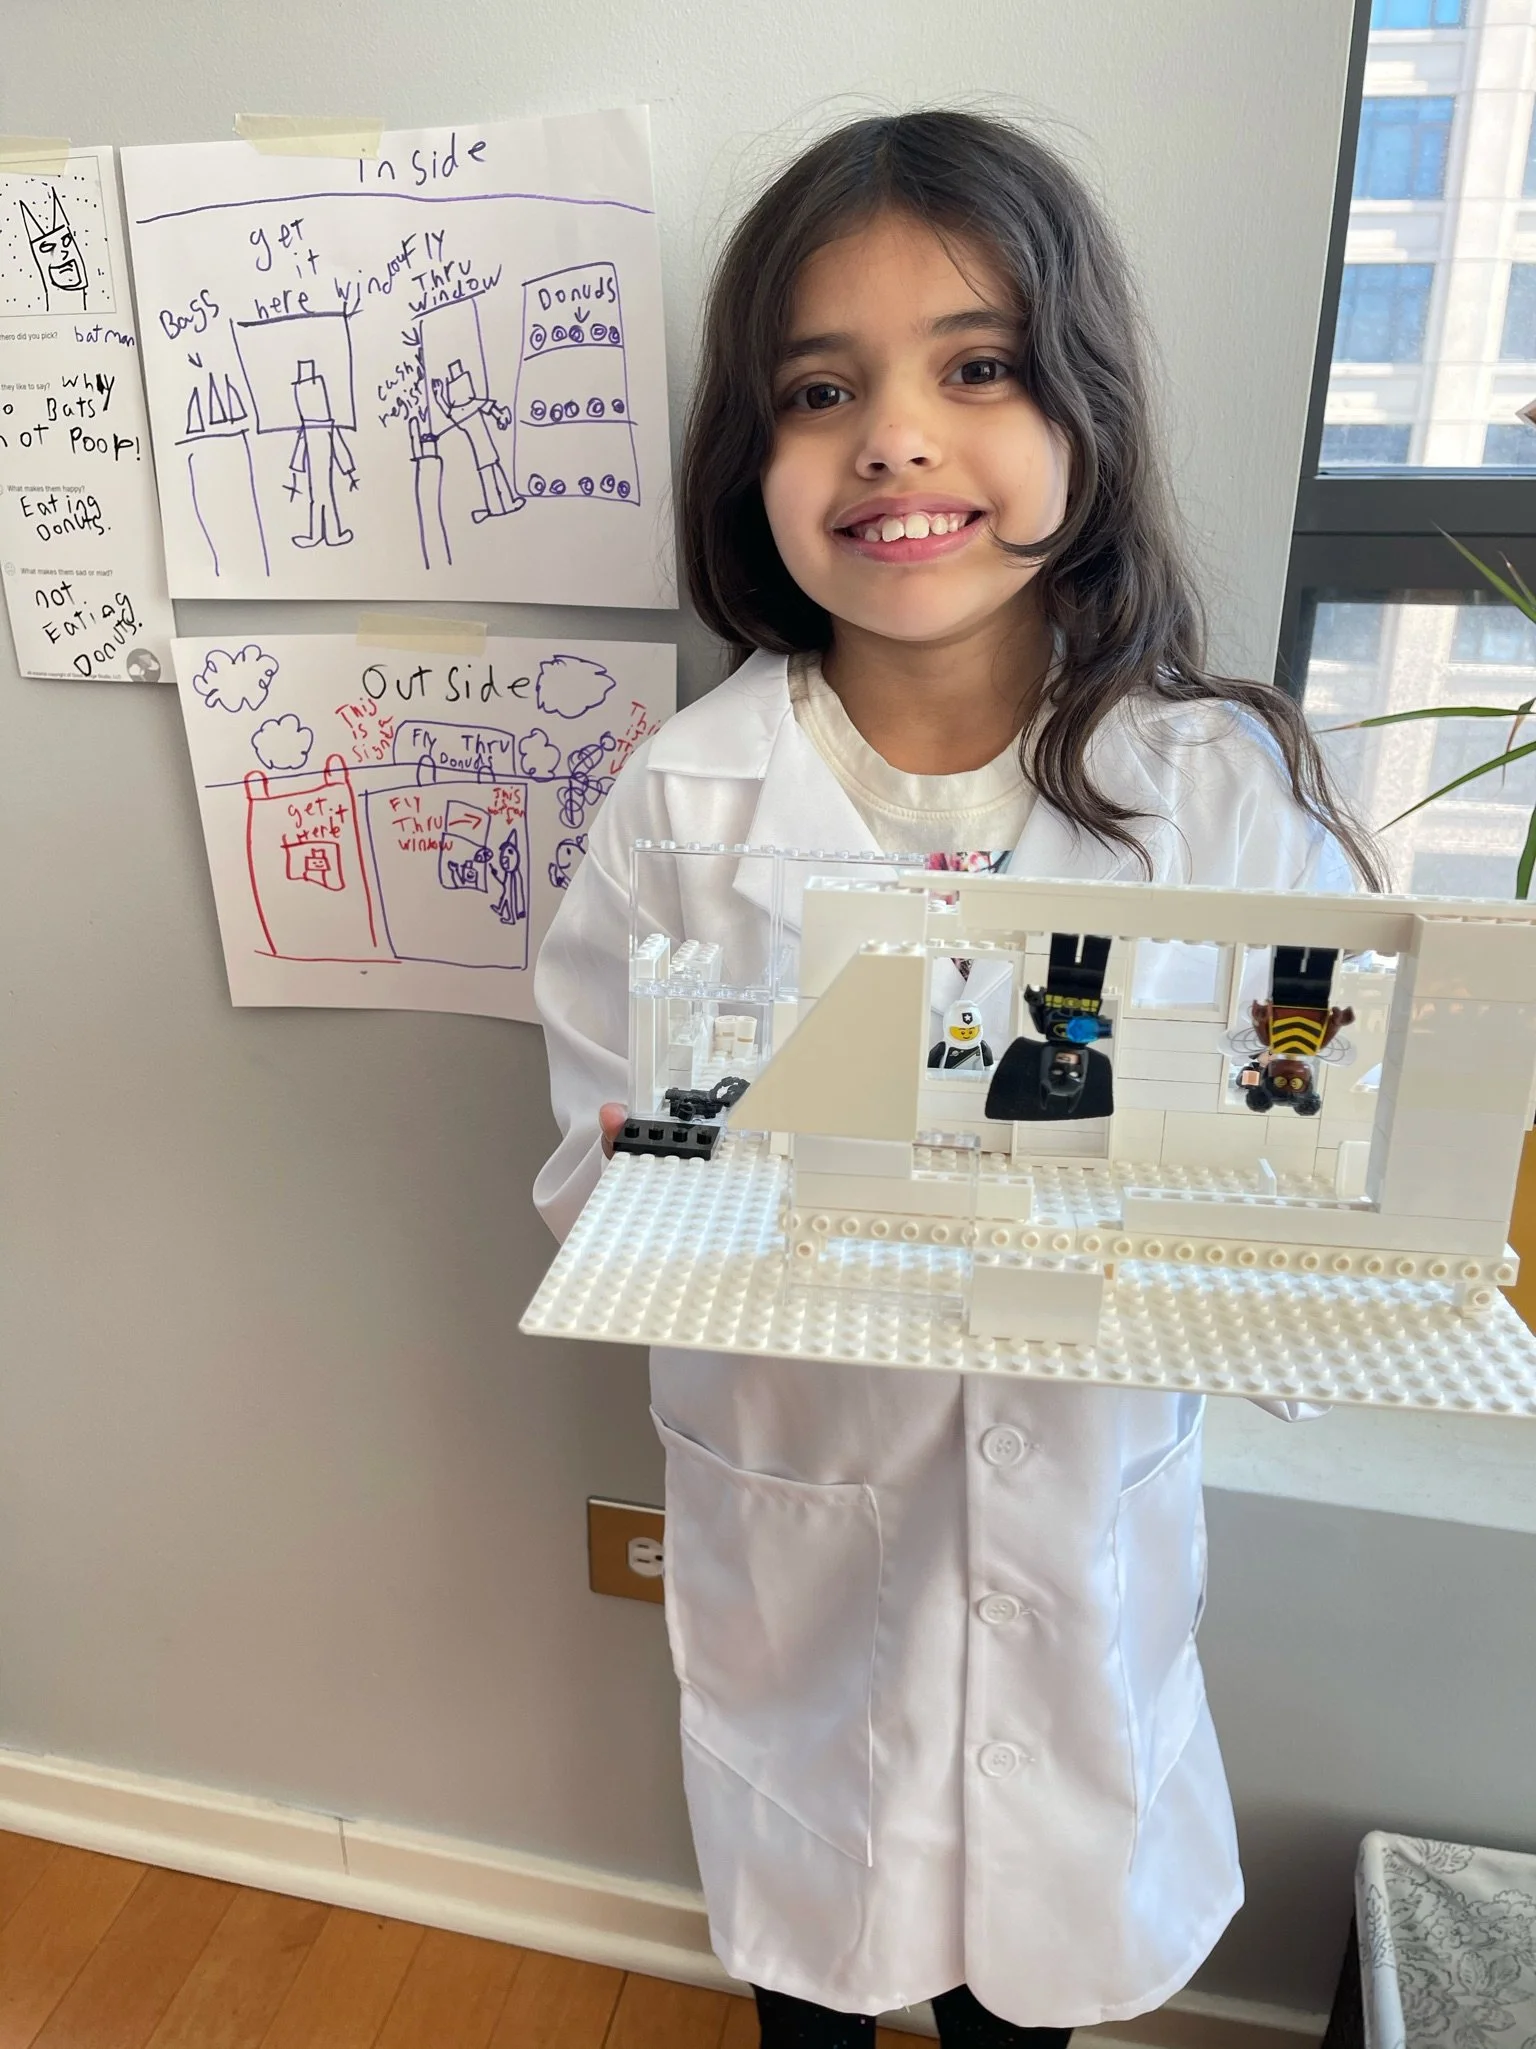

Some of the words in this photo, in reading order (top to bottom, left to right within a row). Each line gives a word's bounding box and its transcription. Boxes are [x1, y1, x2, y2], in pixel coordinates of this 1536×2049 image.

[249, 218, 304, 272] get
[293, 249, 320, 279] it
[159, 289, 219, 340] Bags
[254, 290, 316, 320] here
[16, 332, 27, 340] did
[28, 334, 40, 342] you
[42, 331, 58, 341] pick?
[74, 324, 135, 347] batman
[1, 382, 14, 392] they
[16, 382, 27, 390] like
[36, 382, 50, 392] say?
[47, 397, 96, 421] Bats
[62, 485, 85, 494] happy?
[20, 493, 102, 520] Eating
[287, 796, 327, 829] get
